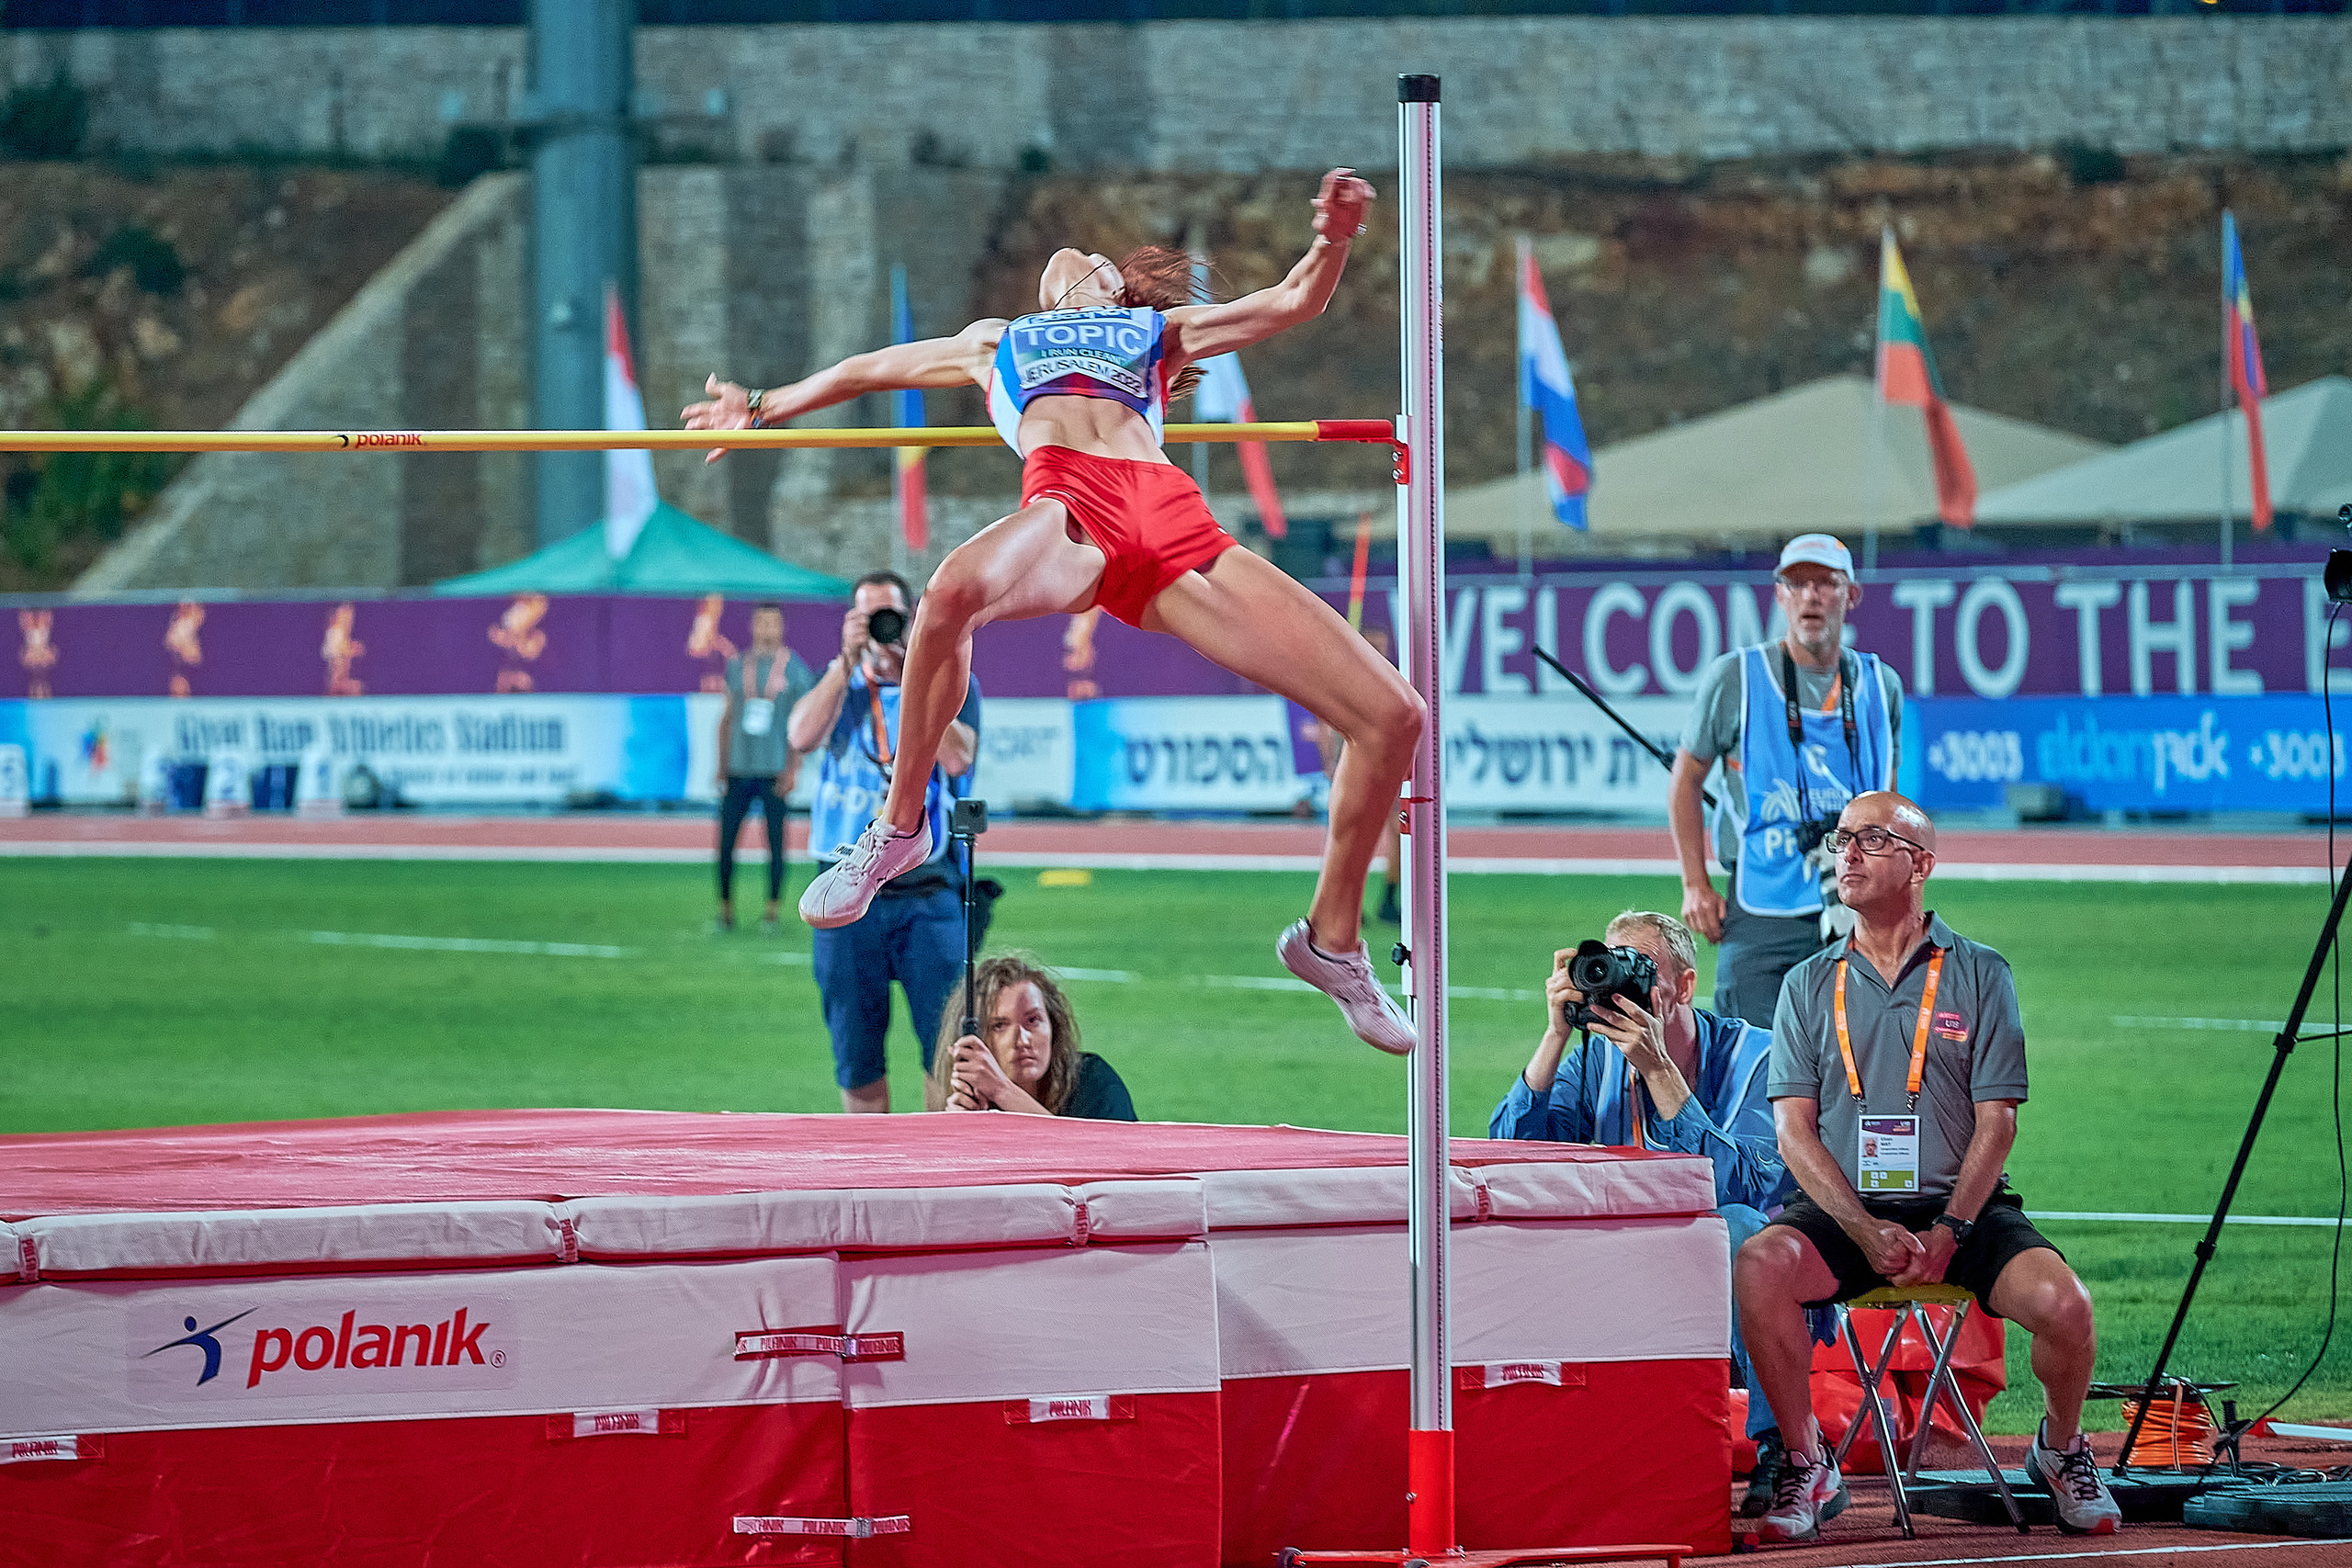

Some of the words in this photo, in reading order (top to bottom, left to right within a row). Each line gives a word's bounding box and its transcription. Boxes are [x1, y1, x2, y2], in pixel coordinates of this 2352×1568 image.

[1019, 324, 1143, 355] TOPIC
[1025, 359, 1112, 383] JERUSALEM
[1110, 369, 1143, 393] 2022
[355, 433, 424, 449] polanik
[1386, 583, 1857, 696] WELCO
[1892, 577, 2030, 698] TO
[2053, 577, 2265, 697] THE
[247, 1306, 491, 1389] polanik
